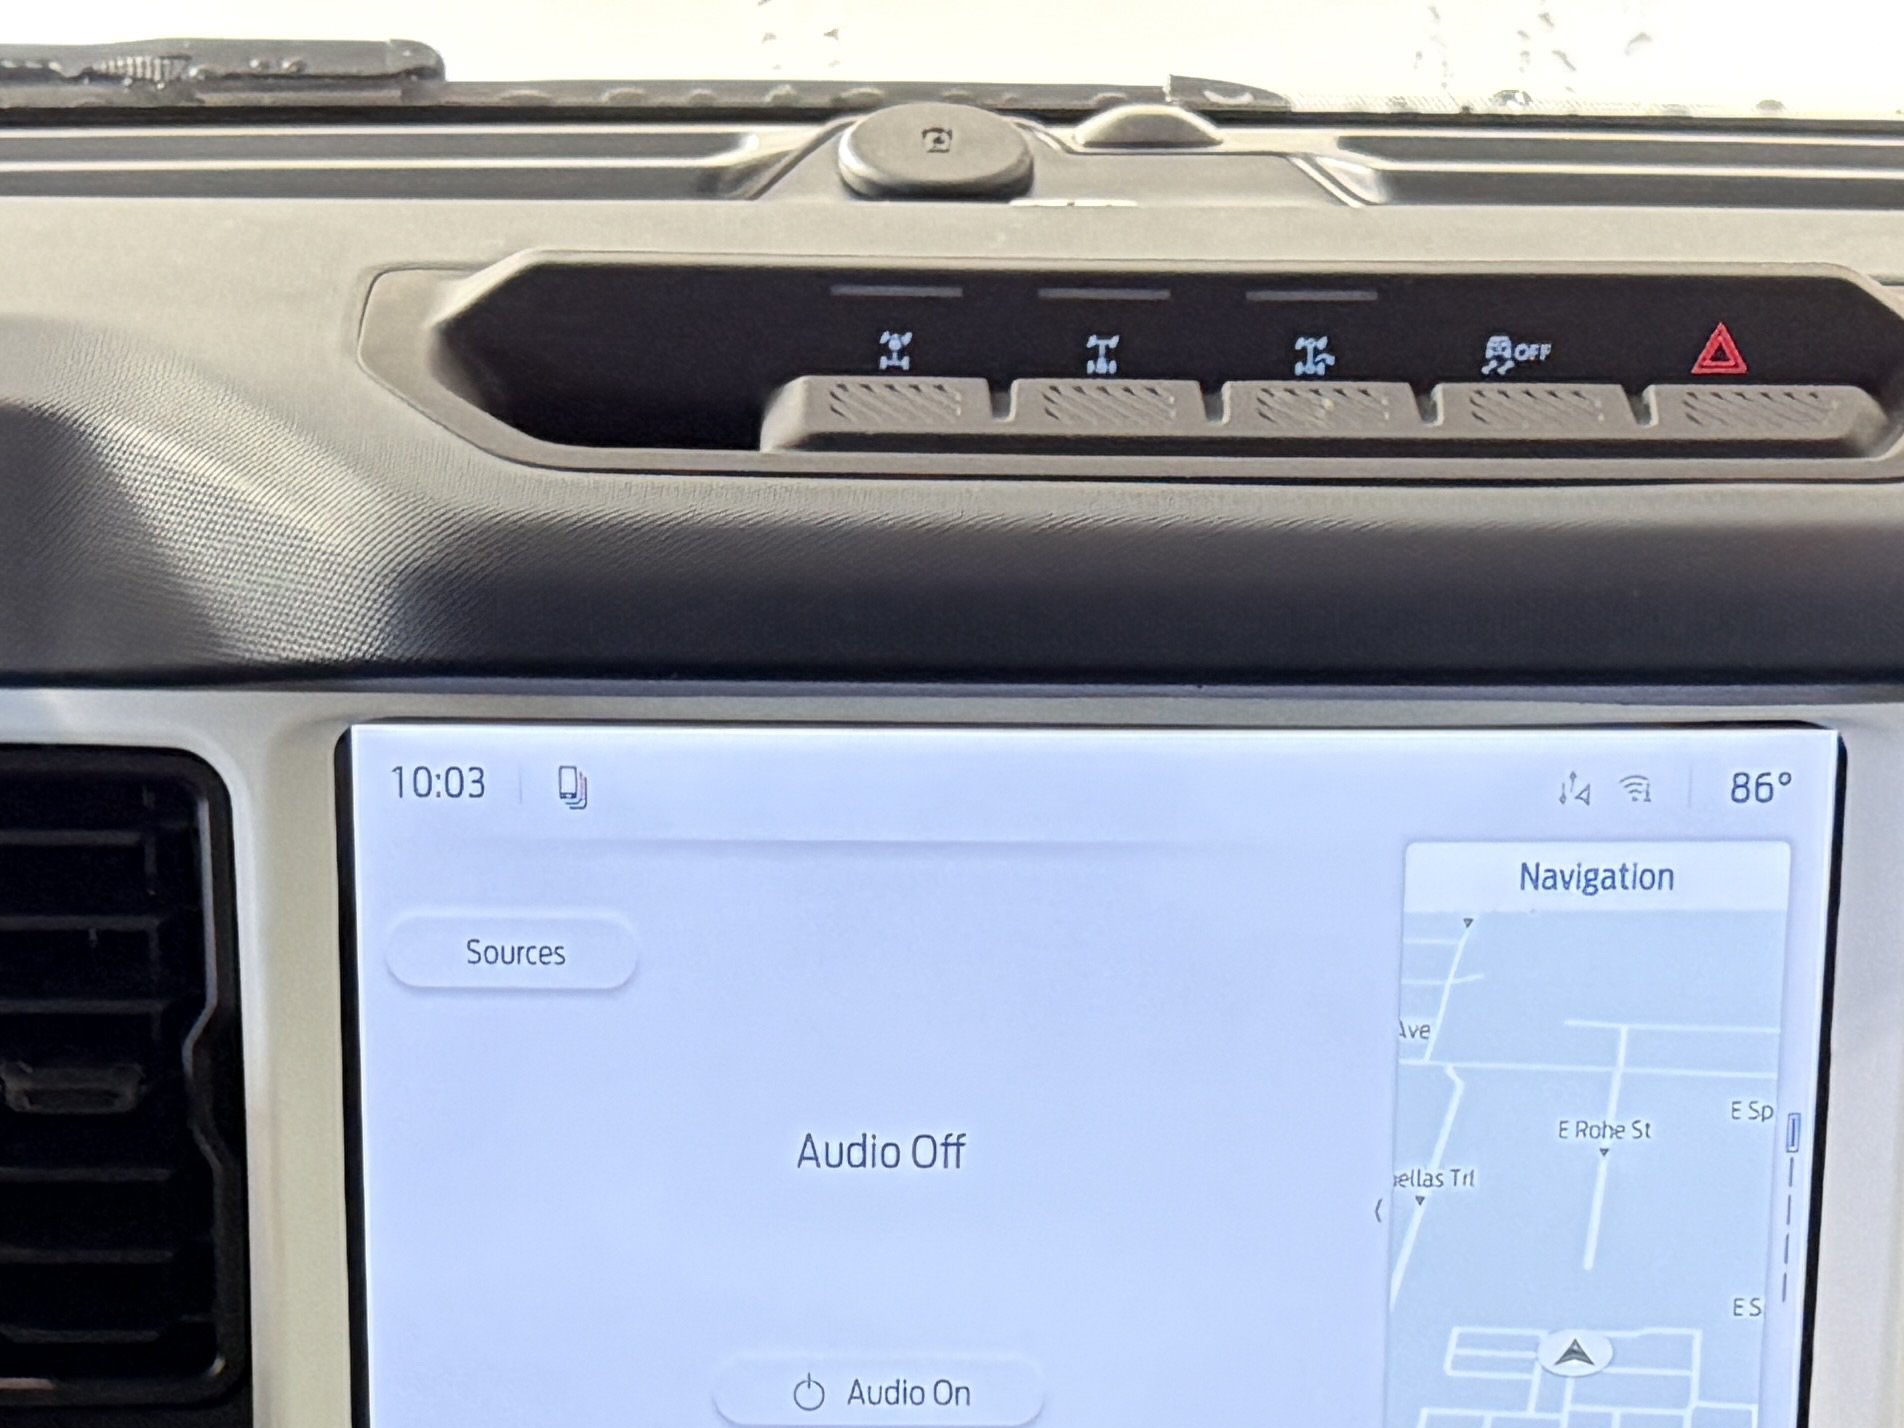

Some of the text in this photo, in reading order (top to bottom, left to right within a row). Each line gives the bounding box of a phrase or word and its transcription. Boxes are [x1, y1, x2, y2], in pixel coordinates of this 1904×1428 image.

[1514, 343, 1552, 361] OFF
[391, 765, 485, 799] 10:03
[1730, 771, 1792, 804] 86°
[1520, 861, 1675, 897] Navigation
[466, 938, 566, 966] Sources
[1731, 1100, 1742, 1120] E
[1558, 1120, 1569, 1139] E
[1631, 1119, 1651, 1140] St
[797, 1132, 967, 1169] Audio Off
[1733, 1297, 1745, 1317] E
[847, 1378, 971, 1407] Audio On
